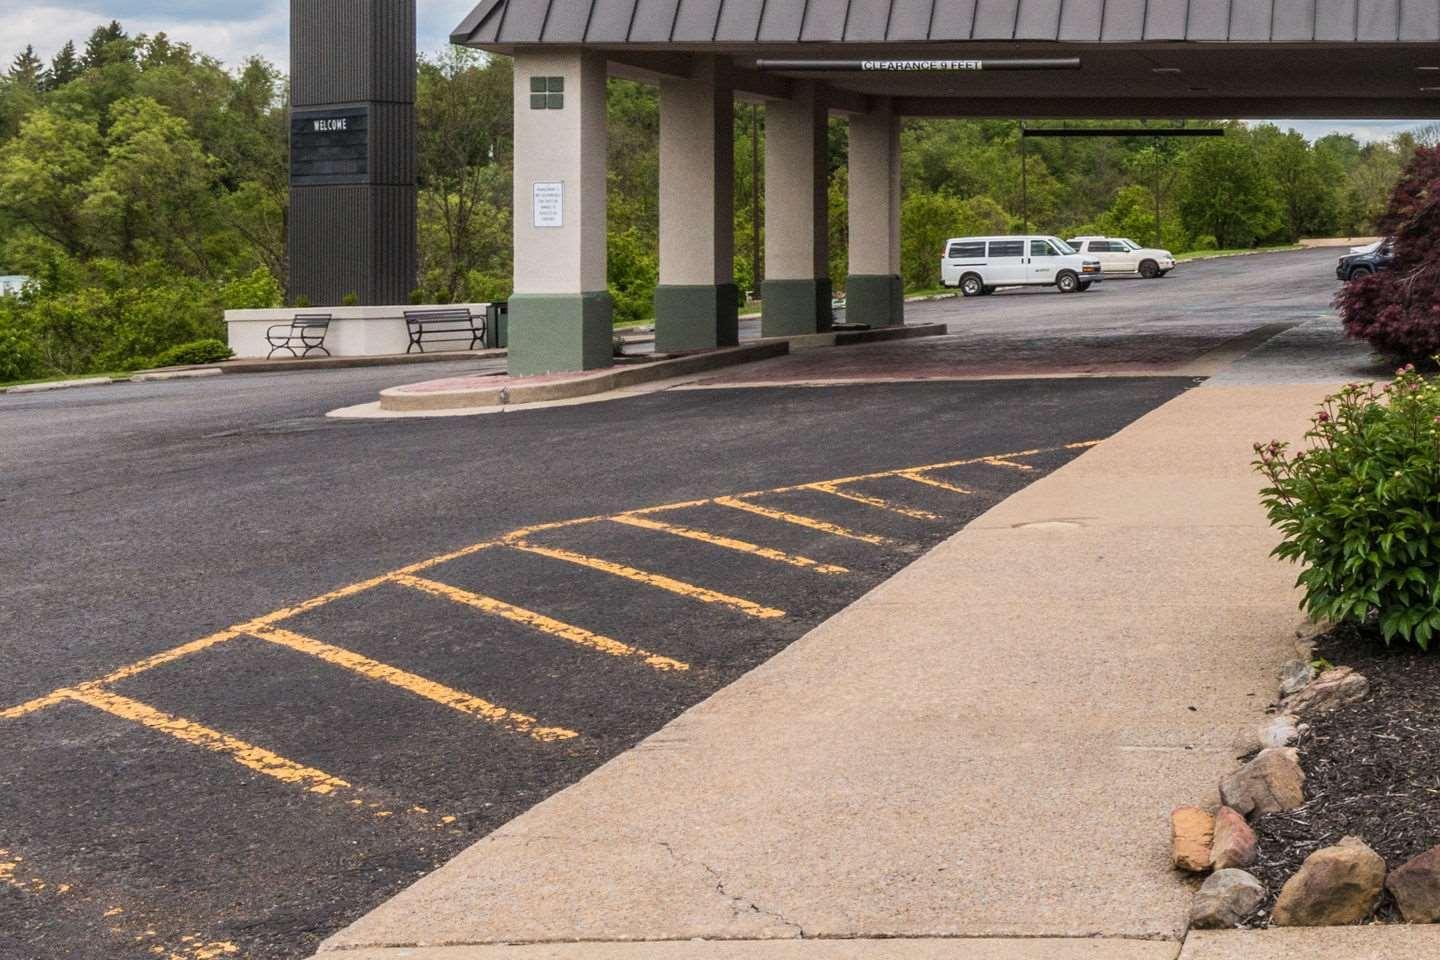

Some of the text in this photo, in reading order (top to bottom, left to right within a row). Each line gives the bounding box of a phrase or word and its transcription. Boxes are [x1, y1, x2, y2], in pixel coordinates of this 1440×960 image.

[864, 61, 937, 70] CLEARANCE
[951, 61, 979, 70] FEET
[313, 118, 347, 131] WELCOME
